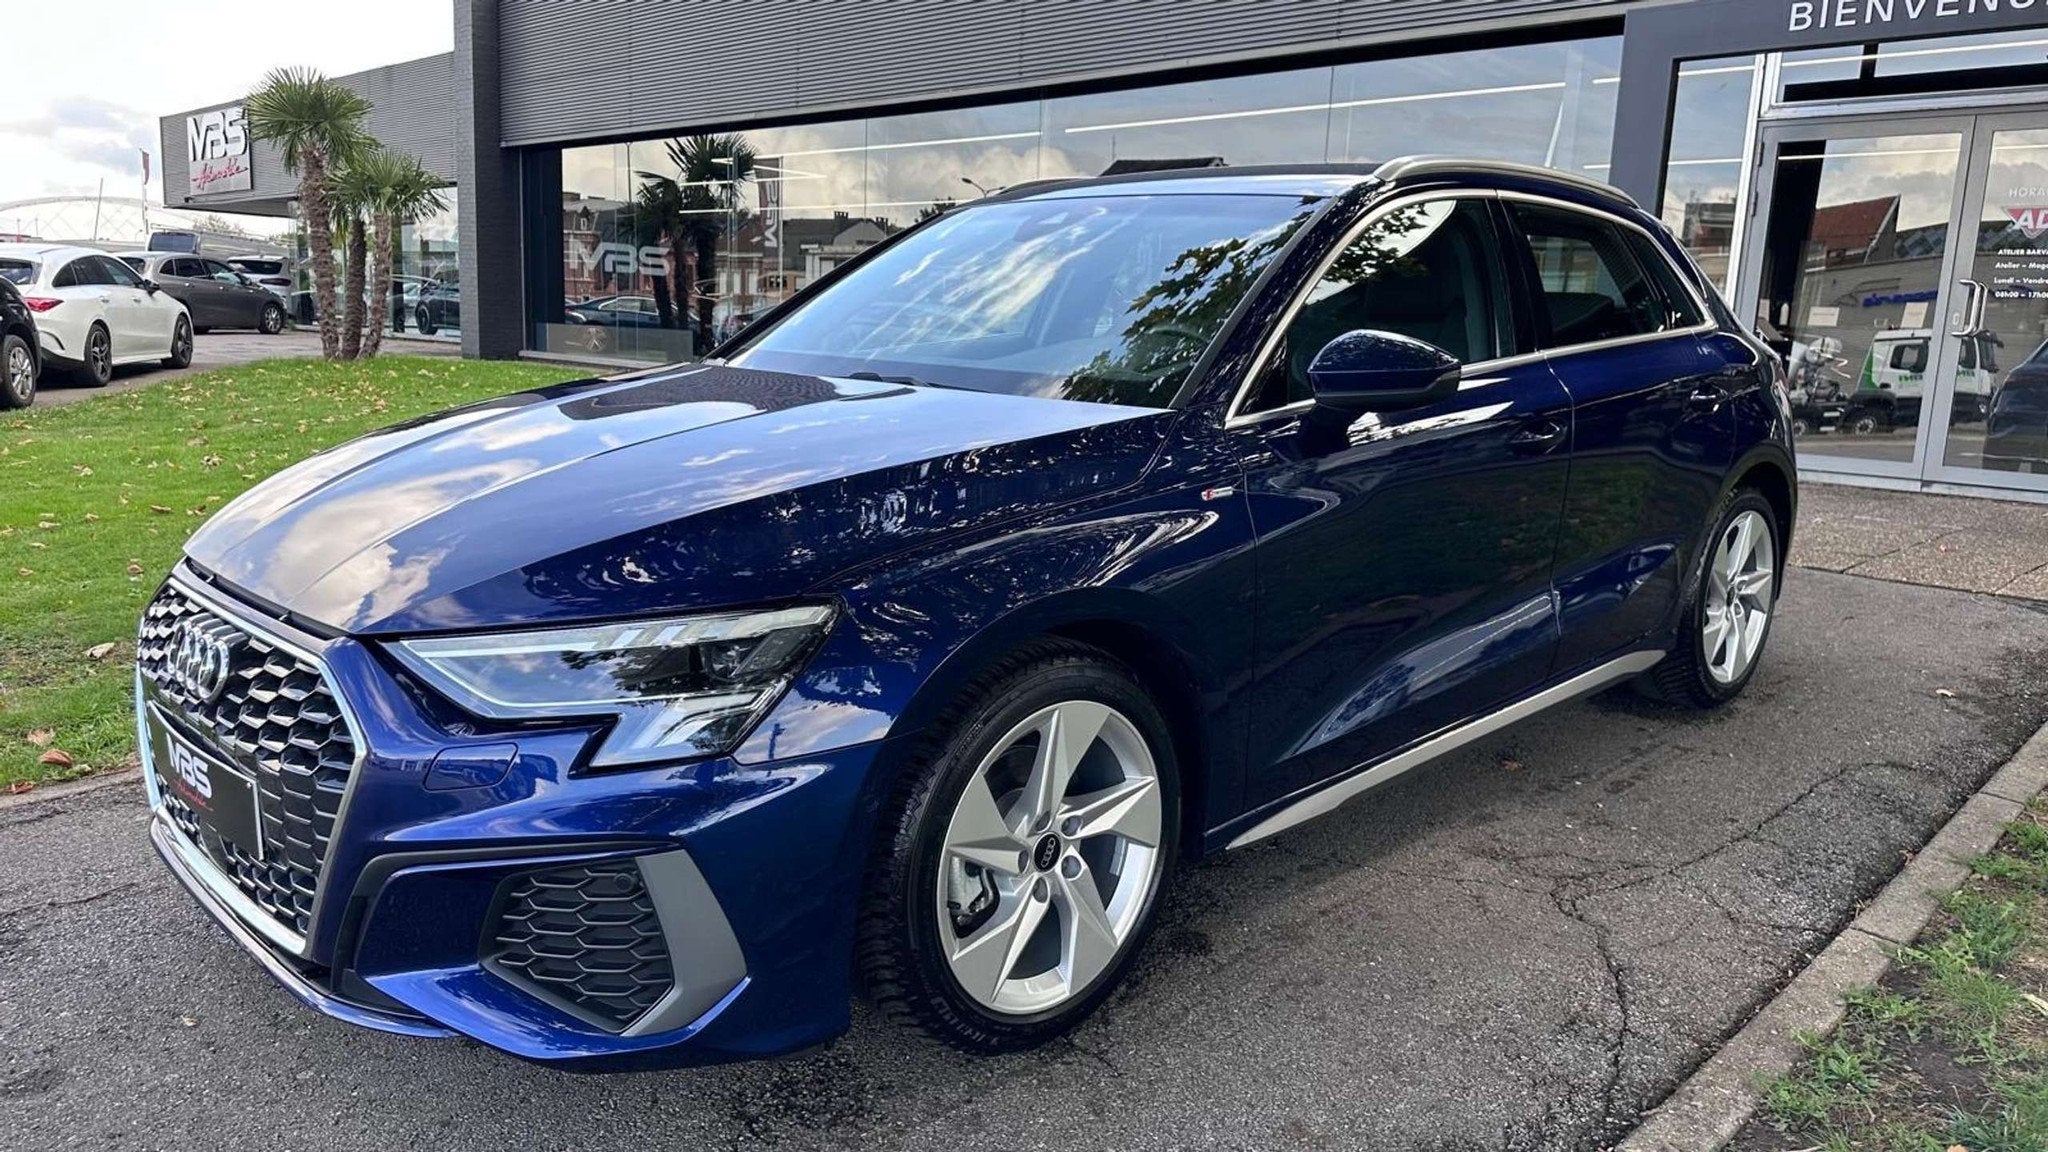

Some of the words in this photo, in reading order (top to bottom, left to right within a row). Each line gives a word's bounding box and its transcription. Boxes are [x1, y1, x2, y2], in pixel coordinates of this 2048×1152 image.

[186, 106, 249, 162] MBS
[568, 238, 671, 276] MBS
[1997, 248, 2025, 256] ATELIER
[1993, 276, 2015, 284] Lundi
[166, 732, 212, 799] MBS
